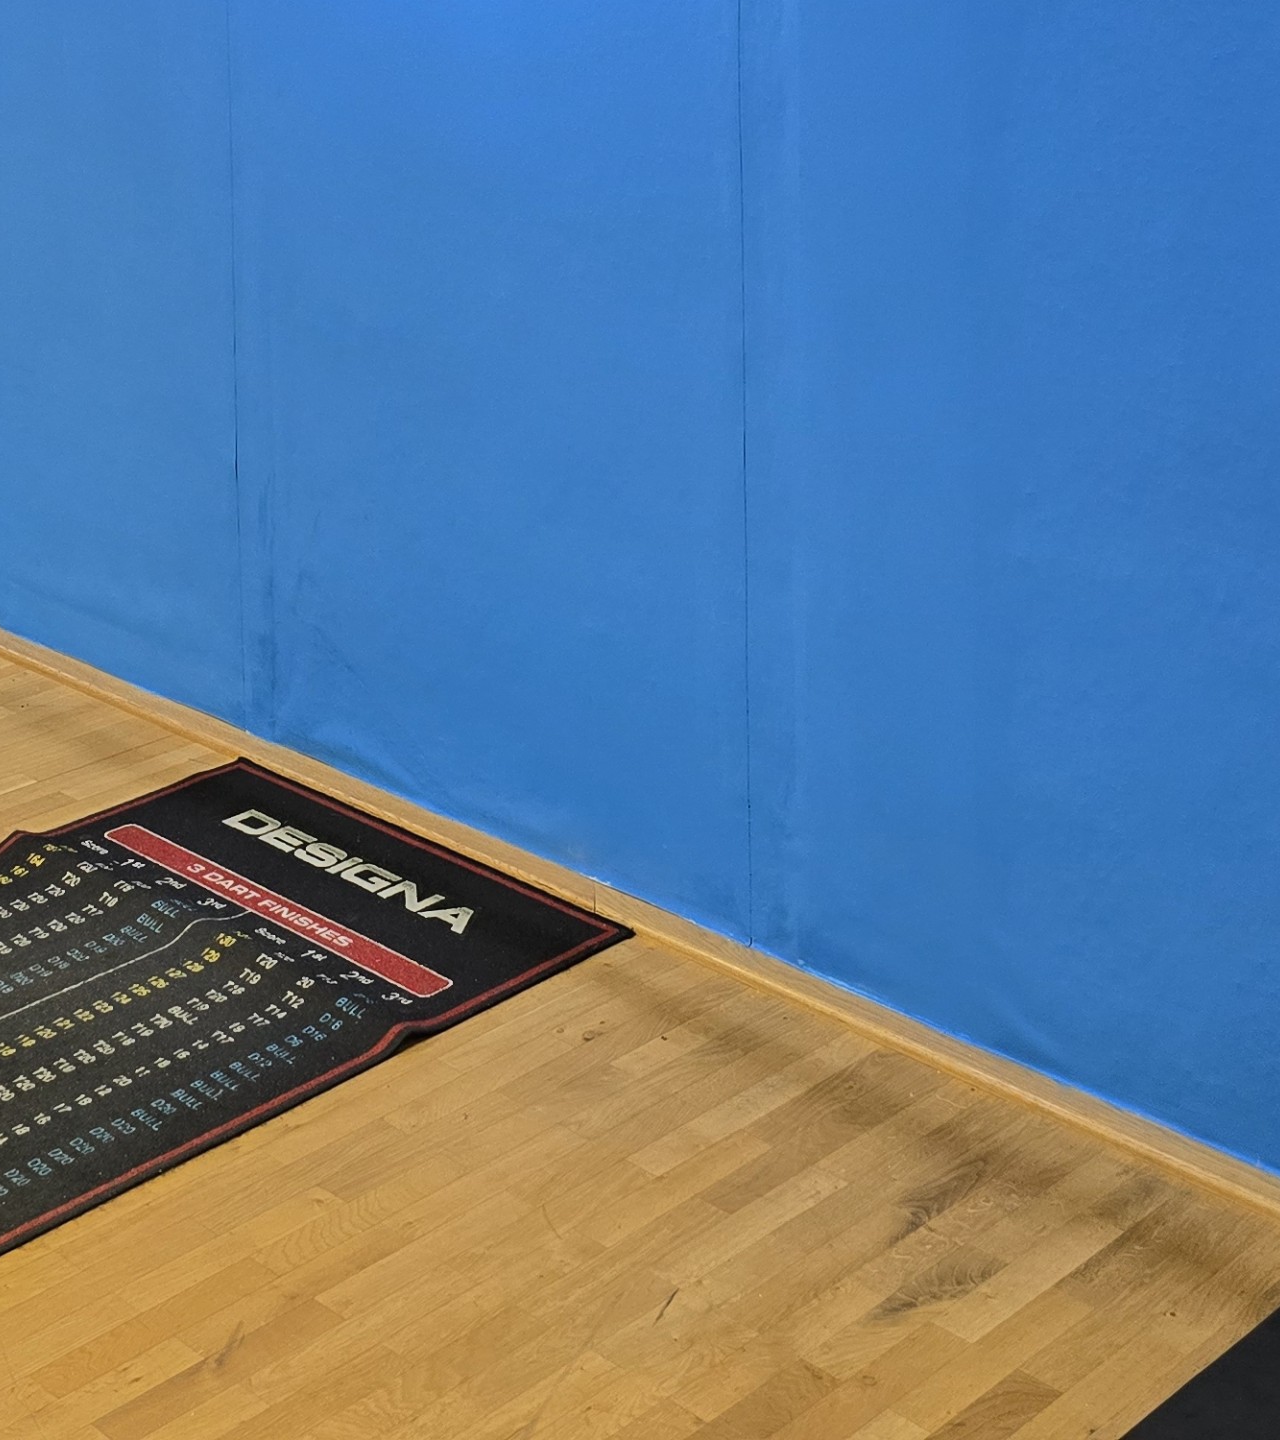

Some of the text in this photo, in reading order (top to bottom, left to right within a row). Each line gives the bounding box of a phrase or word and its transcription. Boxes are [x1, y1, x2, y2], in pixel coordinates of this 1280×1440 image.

[187, 863, 354, 948] 3 DART FINISHES
[221, 808, 476, 934] DESIGNA
[255, 927, 413, 1006] Score 1st 2nd 3rd
